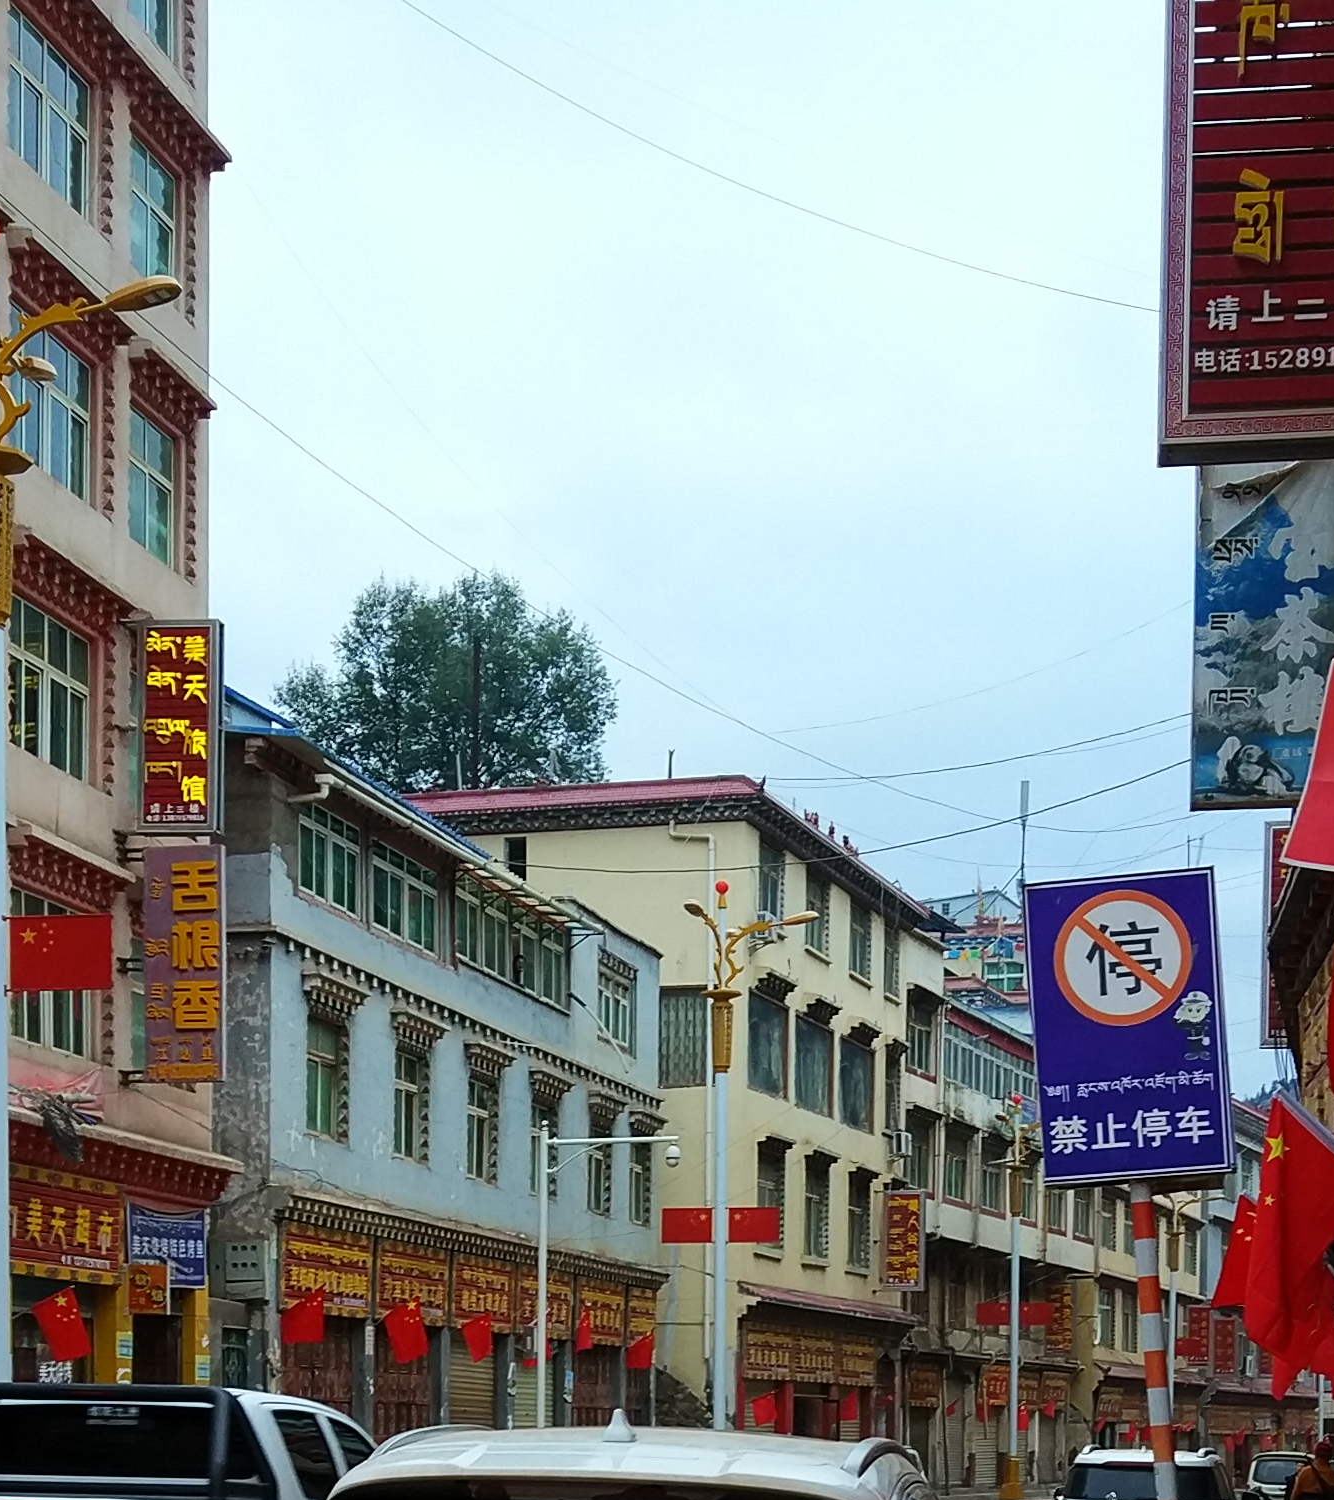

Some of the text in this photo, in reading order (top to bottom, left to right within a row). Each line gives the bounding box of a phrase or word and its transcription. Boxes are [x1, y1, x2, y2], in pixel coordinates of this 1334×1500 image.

[181, 634, 208, 806] 美天旅馆
[171, 860, 219, 1031] 舌根香
[1085, 921, 1163, 997] 停
[1049, 1105, 1215, 1155] 禁止停车
[26, 1197, 115, 1255] 美天超市
